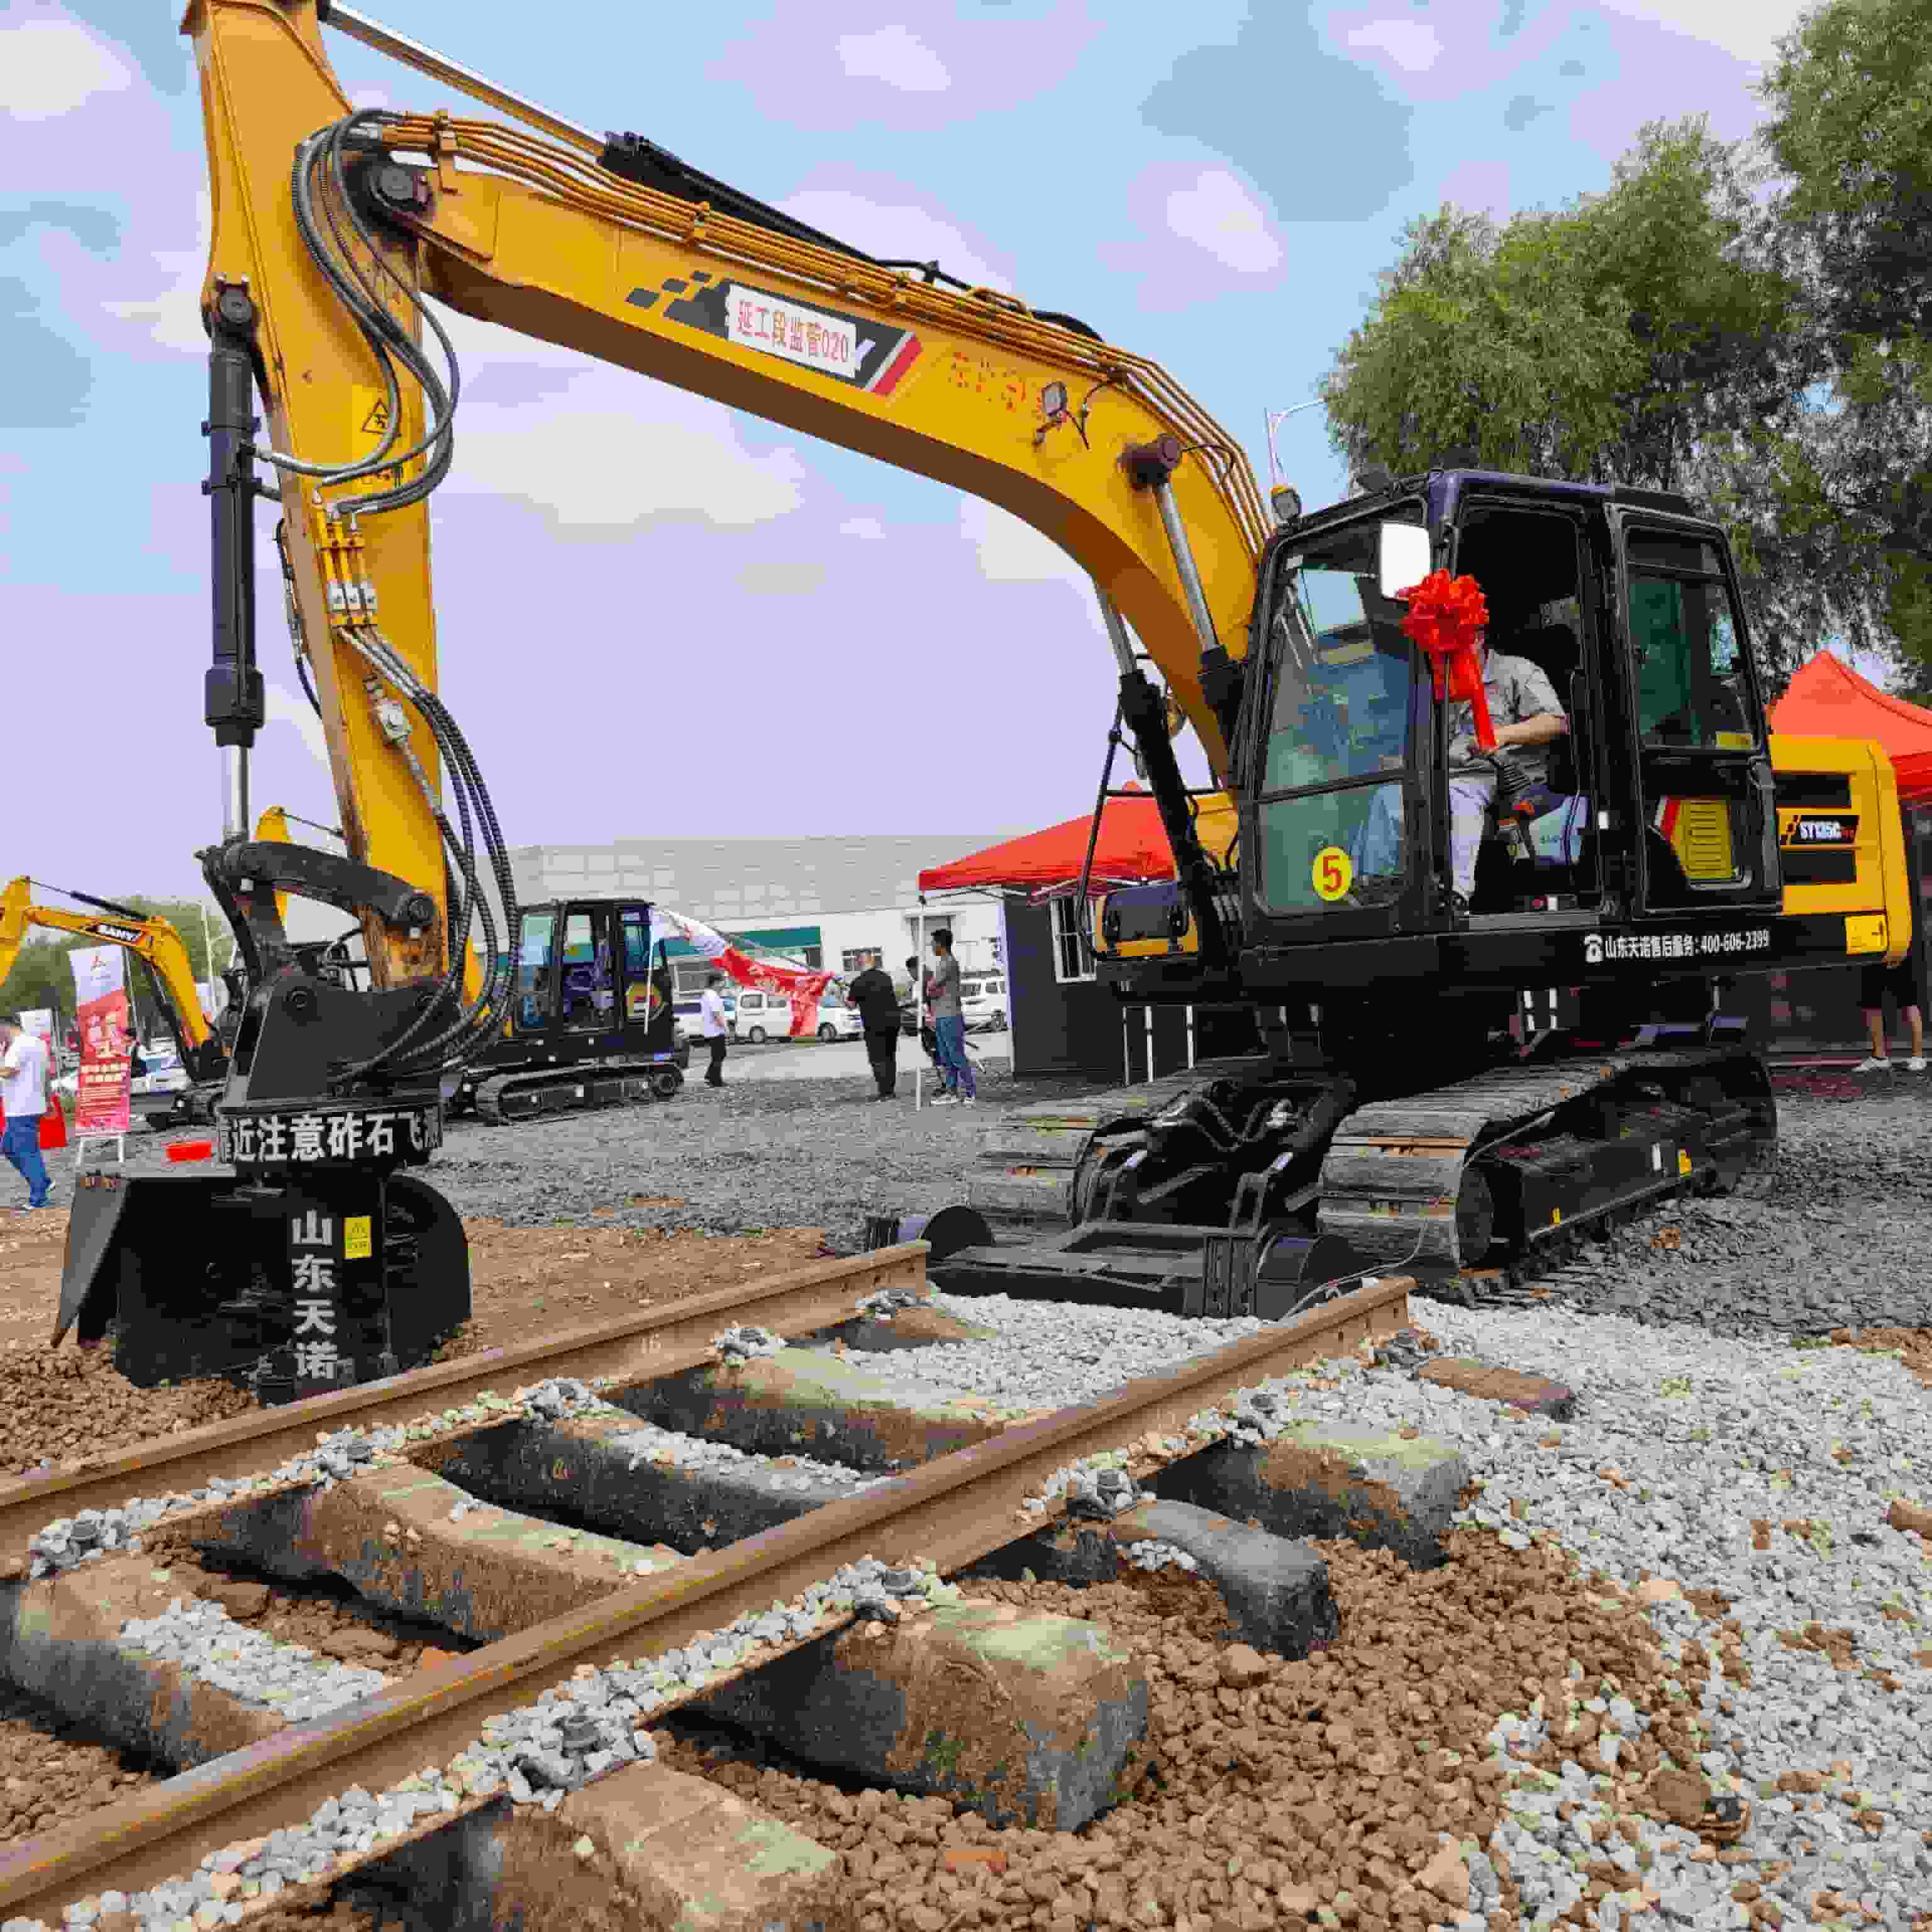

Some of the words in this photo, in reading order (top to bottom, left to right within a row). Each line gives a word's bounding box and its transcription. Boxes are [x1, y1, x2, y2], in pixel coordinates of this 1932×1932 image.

[1323, 855, 1343, 892] 5
[291, 1209, 338, 1379] 山东天诺
